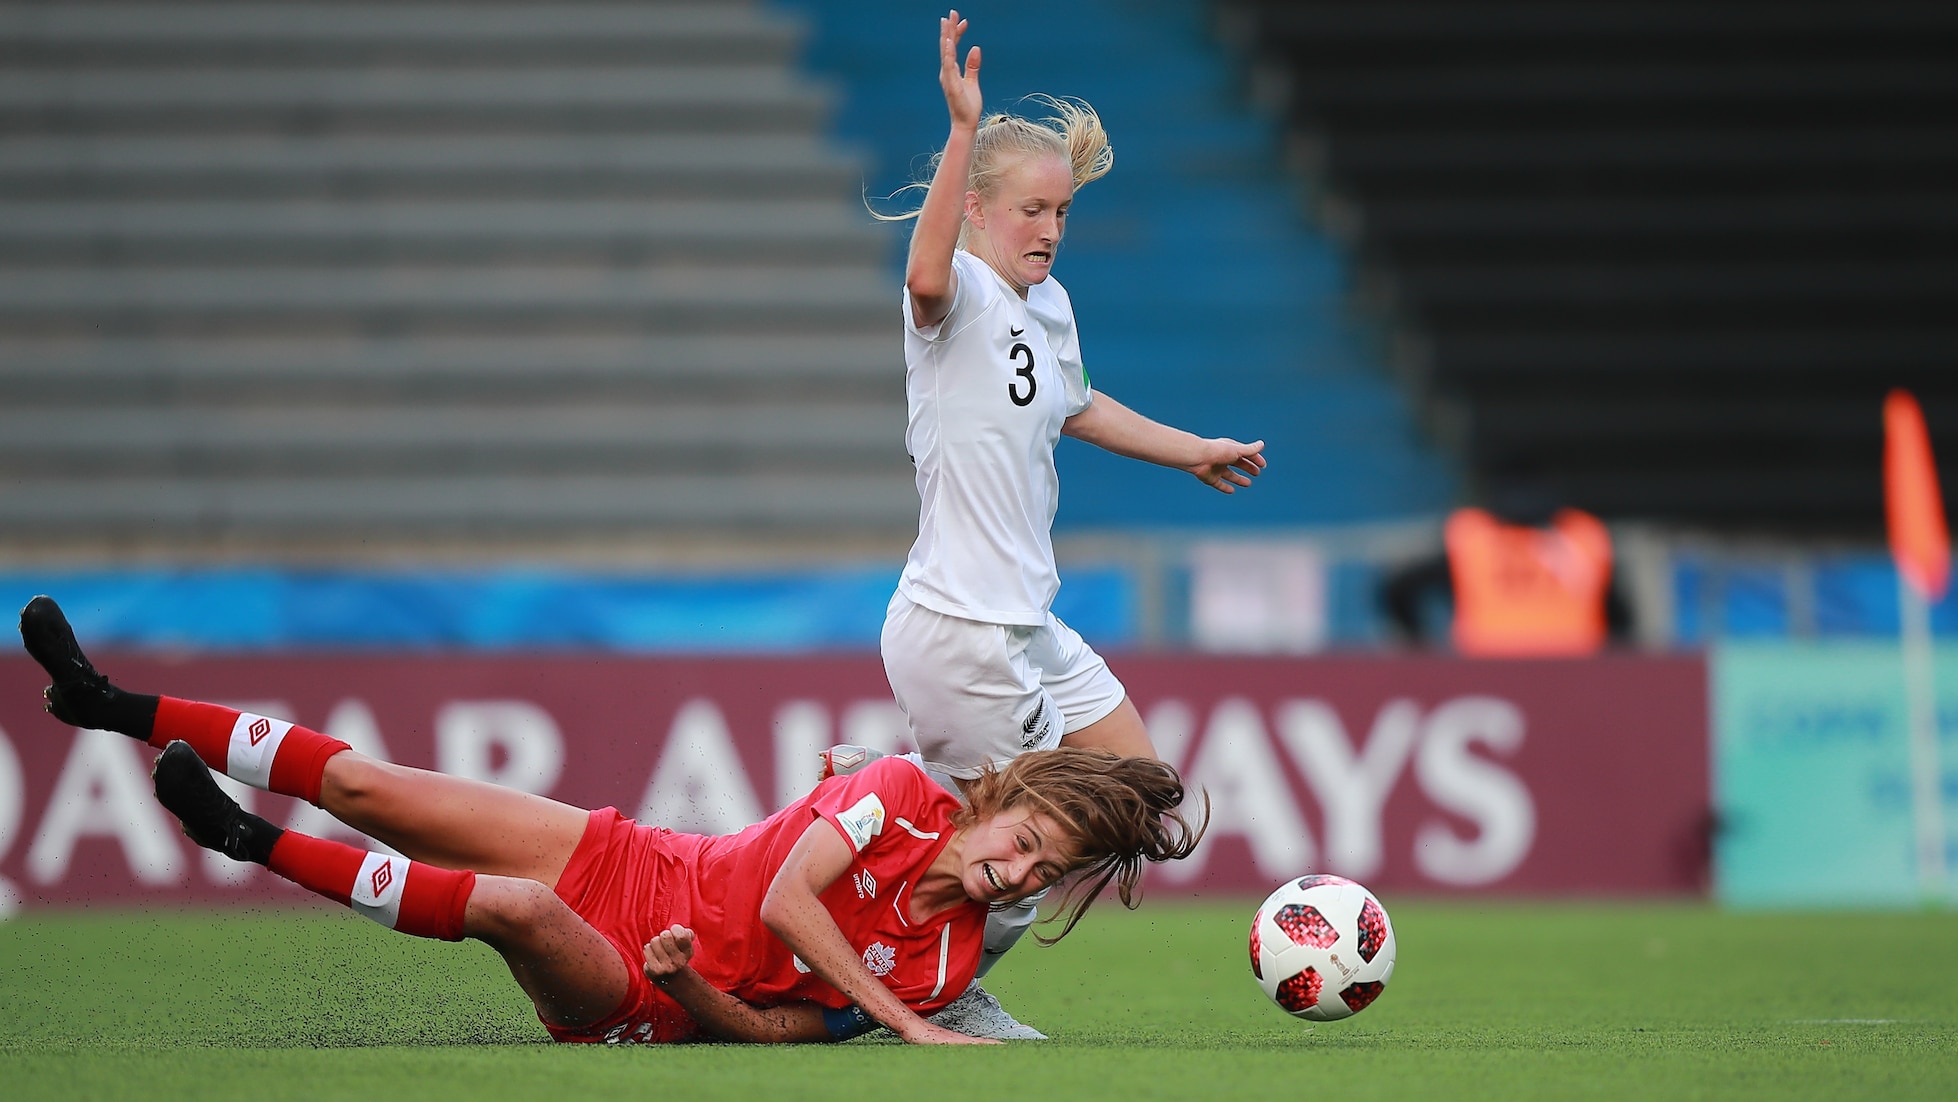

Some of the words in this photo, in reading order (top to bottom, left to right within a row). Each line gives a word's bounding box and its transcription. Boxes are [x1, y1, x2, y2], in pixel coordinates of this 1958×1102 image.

[1008, 343, 1037, 407] 3
[632, 696, 1535, 887] AIAYS
[852, 872, 865, 900] umbro
[867, 944, 890, 976] CANADA
